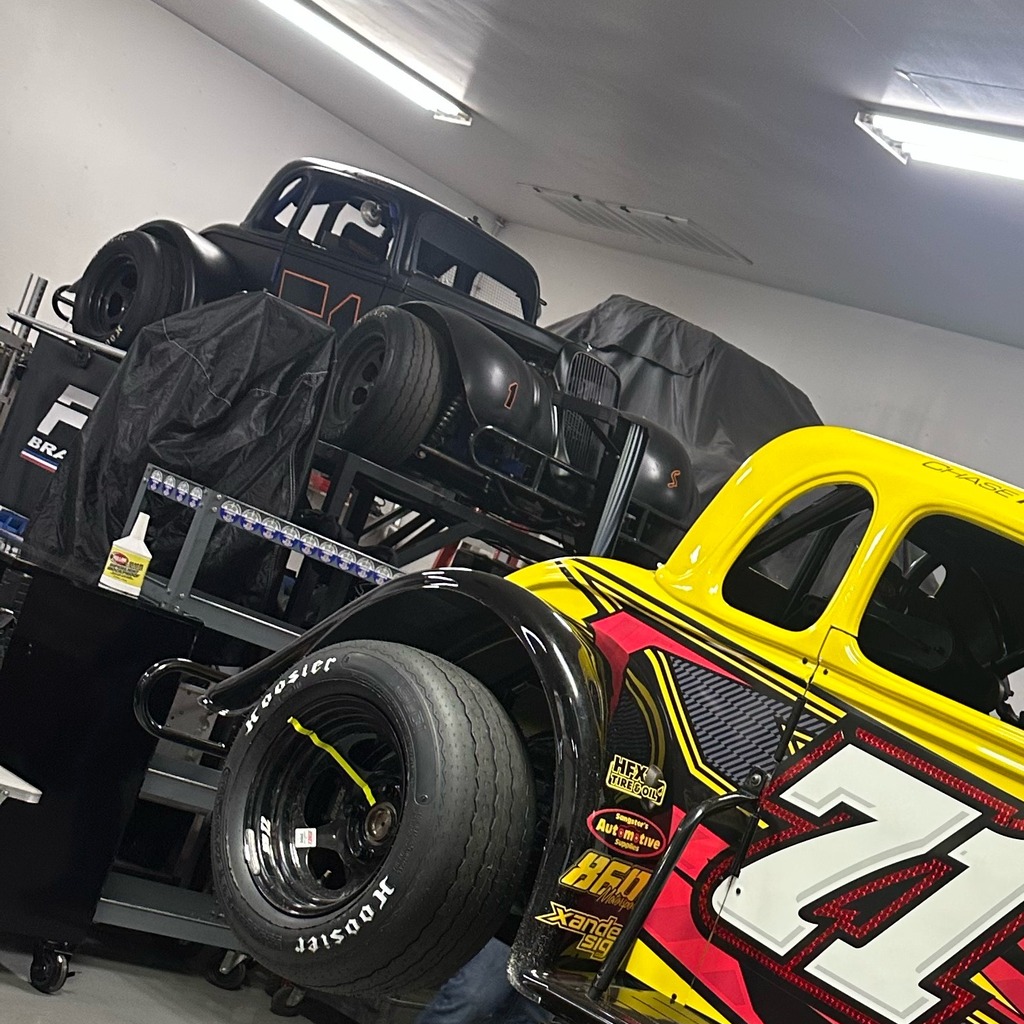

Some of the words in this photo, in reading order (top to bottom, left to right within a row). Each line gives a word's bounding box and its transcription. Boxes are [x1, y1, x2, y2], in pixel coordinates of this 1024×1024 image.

[922, 461, 1020, 498] CHASE
[245, 657, 337, 736] Hoosier
[610, 775, 633, 791] TIRE
[613, 756, 648, 782] HFX
[595, 818, 661, 850] Automotive
[294, 875, 395, 954] Hoosier
